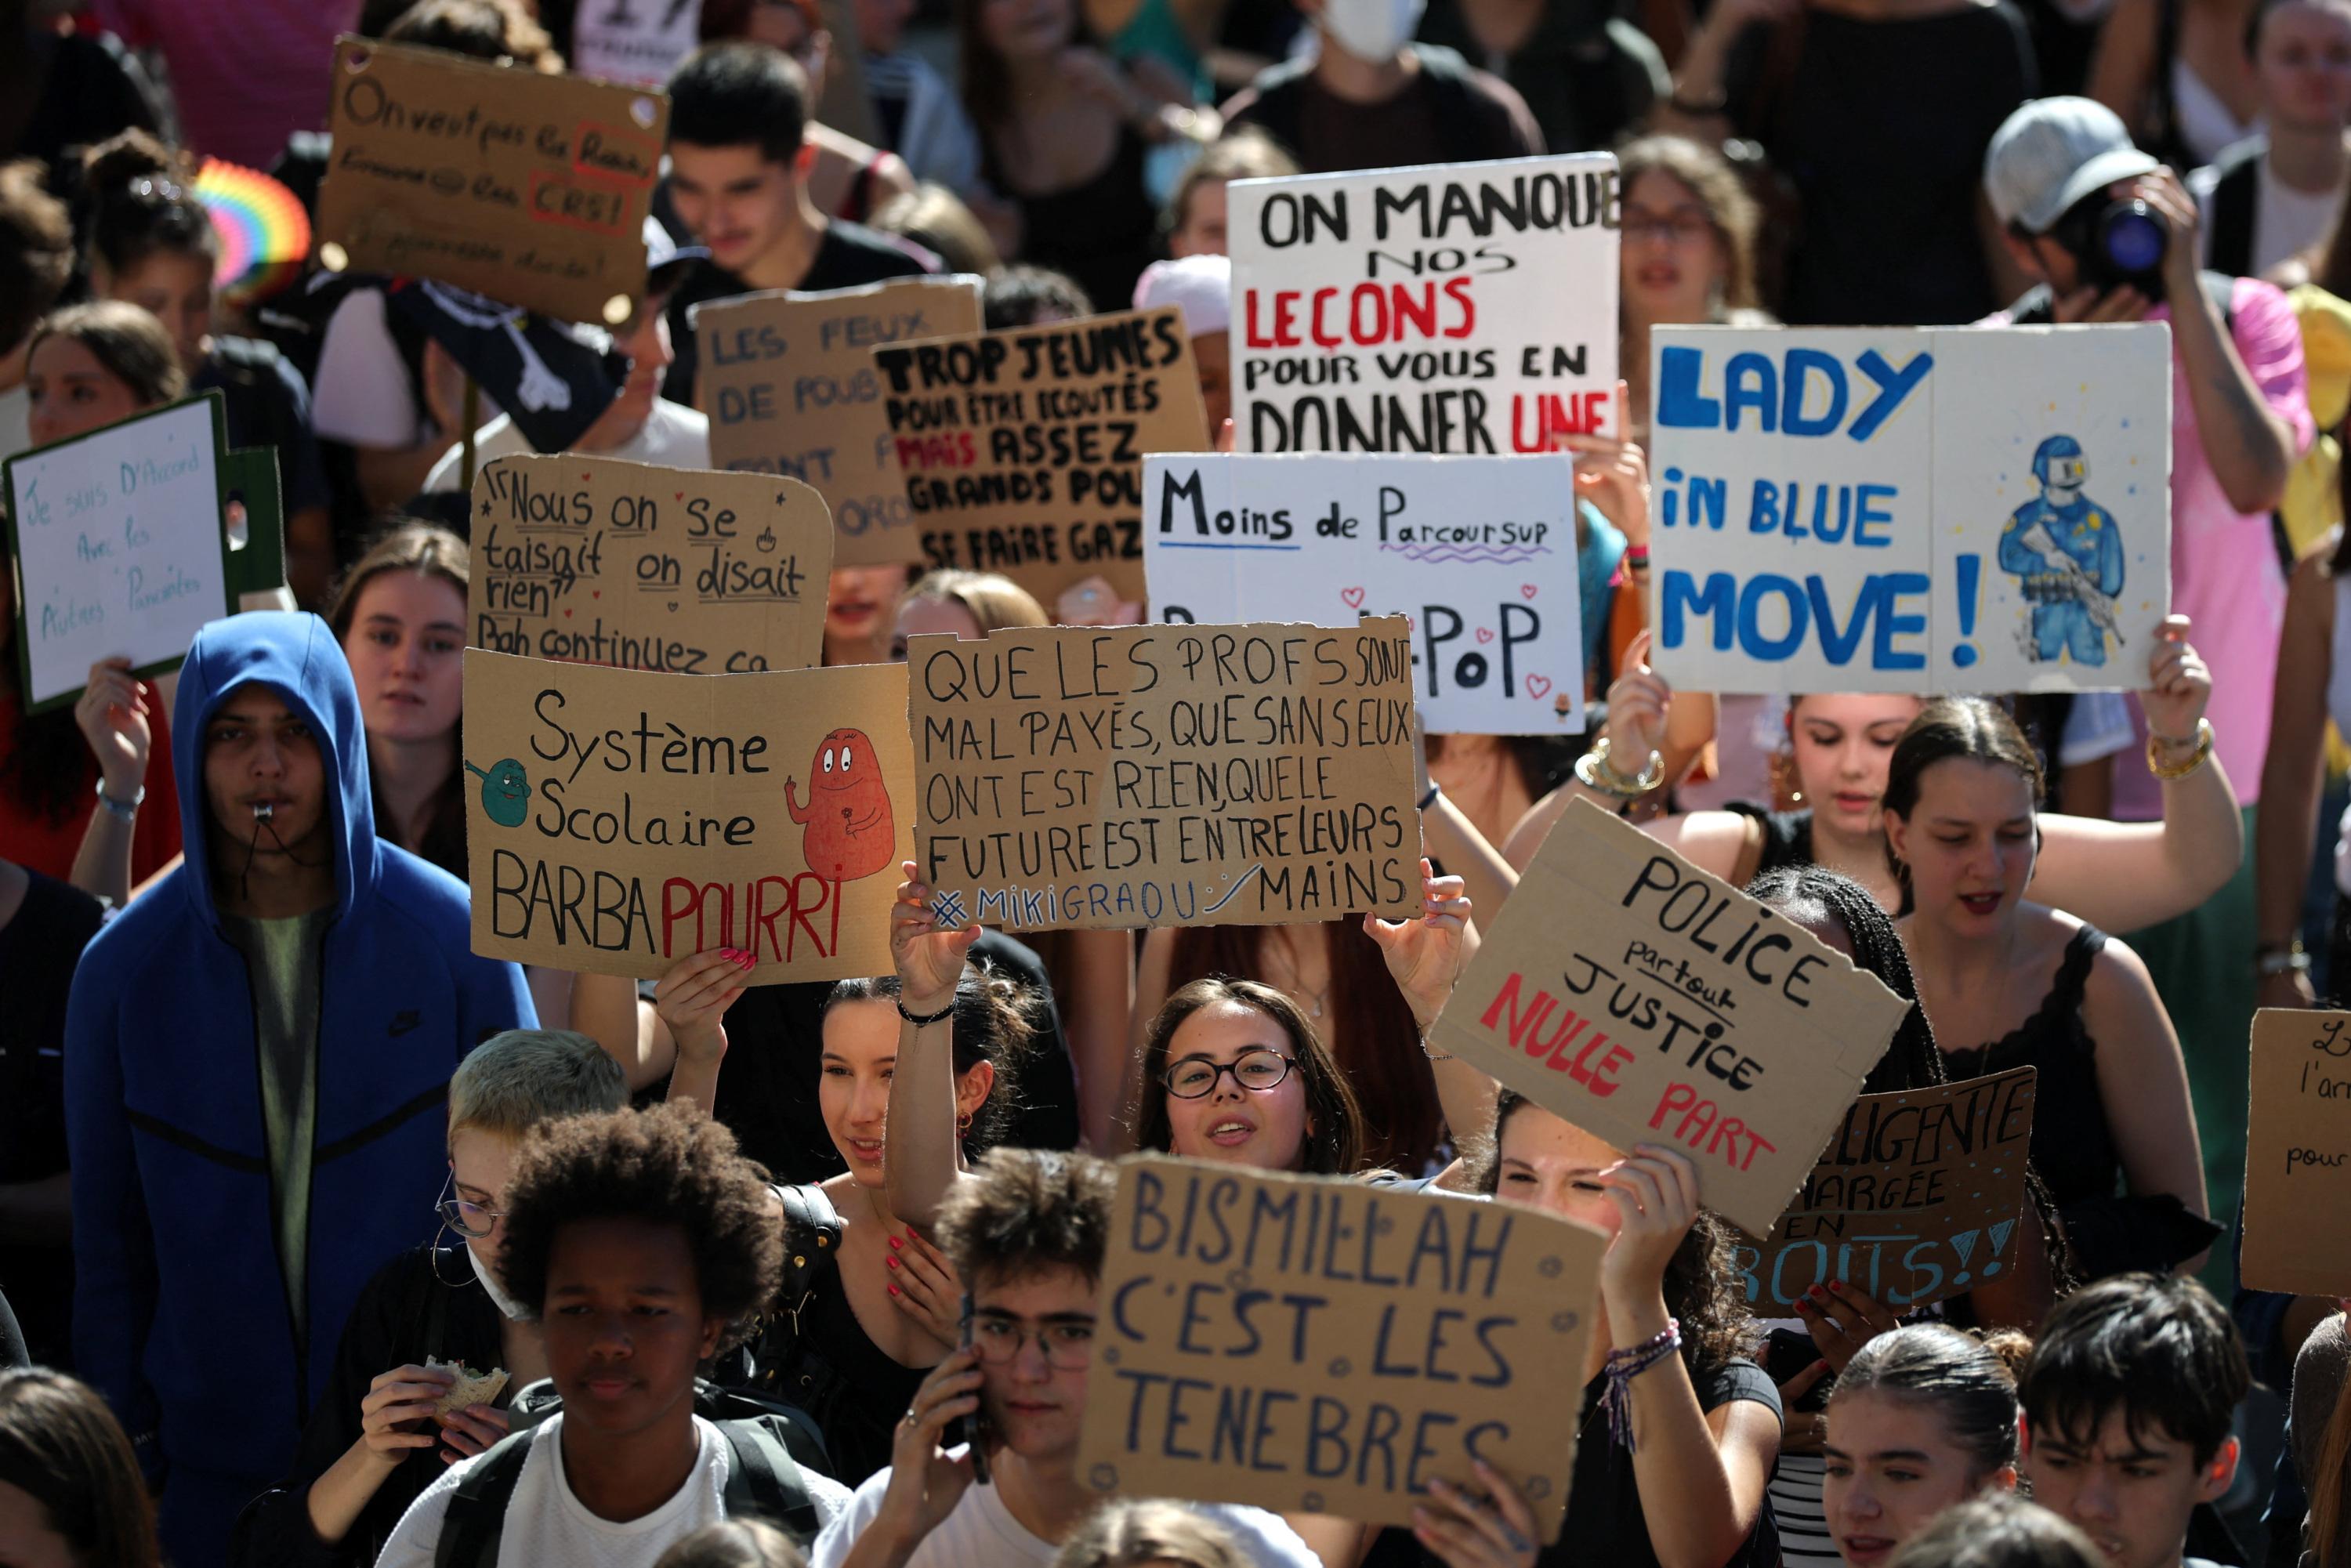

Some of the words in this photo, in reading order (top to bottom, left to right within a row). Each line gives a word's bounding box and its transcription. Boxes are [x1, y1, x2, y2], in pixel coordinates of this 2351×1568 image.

[343, 76, 405, 127] On
[1260, 190, 1348, 249] ON
[1374, 169, 1622, 241] MANQUE
[1367, 241, 1518, 279] NOS
[711, 324, 789, 367] LES
[820, 308, 933, 353] FEUX
[1244, 275, 1477, 355] LEÇONS
[875, 337, 1009, 393] TROP
[1019, 313, 1183, 381] JEUNES
[1244, 352, 1360, 392] POUR
[1375, 348, 1498, 382] VOUS
[1520, 345, 1588, 378] EN
[716, 383, 778, 425] DE
[886, 394, 962, 432] POUR
[1249, 389, 1498, 454] DONNER
[1510, 392, 1610, 454] UNE
[1657, 346, 1935, 444] LADY
[991, 421, 1138, 467] ASSEZ
[610, 494, 658, 531] on
[906, 469, 1053, 514] GRANDS
[1159, 469, 1294, 541] Moins
[1315, 501, 1360, 540] de
[1748, 479, 1899, 547] BLUE
[480, 523, 604, 579] taisait
[636, 553, 683, 585] on
[696, 546, 806, 599] disait
[539, 617, 709, 675] continuez
[1661, 570, 1932, 671] MOVE
[923, 645, 1042, 704] QUE
[1056, 636, 1160, 702] LES
[1176, 632, 1348, 687] PROFS
[1353, 636, 1411, 687] SONT
[530, 688, 770, 784] Système
[925, 714, 1016, 763] MAL
[1169, 693, 1246, 748] QUE
[1253, 695, 1349, 748] SANS
[1357, 697, 1411, 747] EUX
[535, 777, 756, 847] Scolaire
[926, 772, 1005, 827] ONT
[1021, 768, 1095, 817] EST
[928, 823, 1096, 885] FUTURE
[1103, 817, 1161, 871] EST
[1179, 808, 1295, 864] ENTRE
[1298, 802, 1404, 856] LEURS
[1623, 940, 1738, 1012] partout
[1480, 972, 1637, 1099] NULLE
[1646, 1081, 1778, 1173] PART
[2287, 1146, 2349, 1175] pour
[1783, 1213, 1846, 1240] EN
[1111, 1274, 1329, 1364] C'EST
[1371, 1303, 1519, 1389] LES
[1113, 1367, 1510, 1497] TENEBRES
